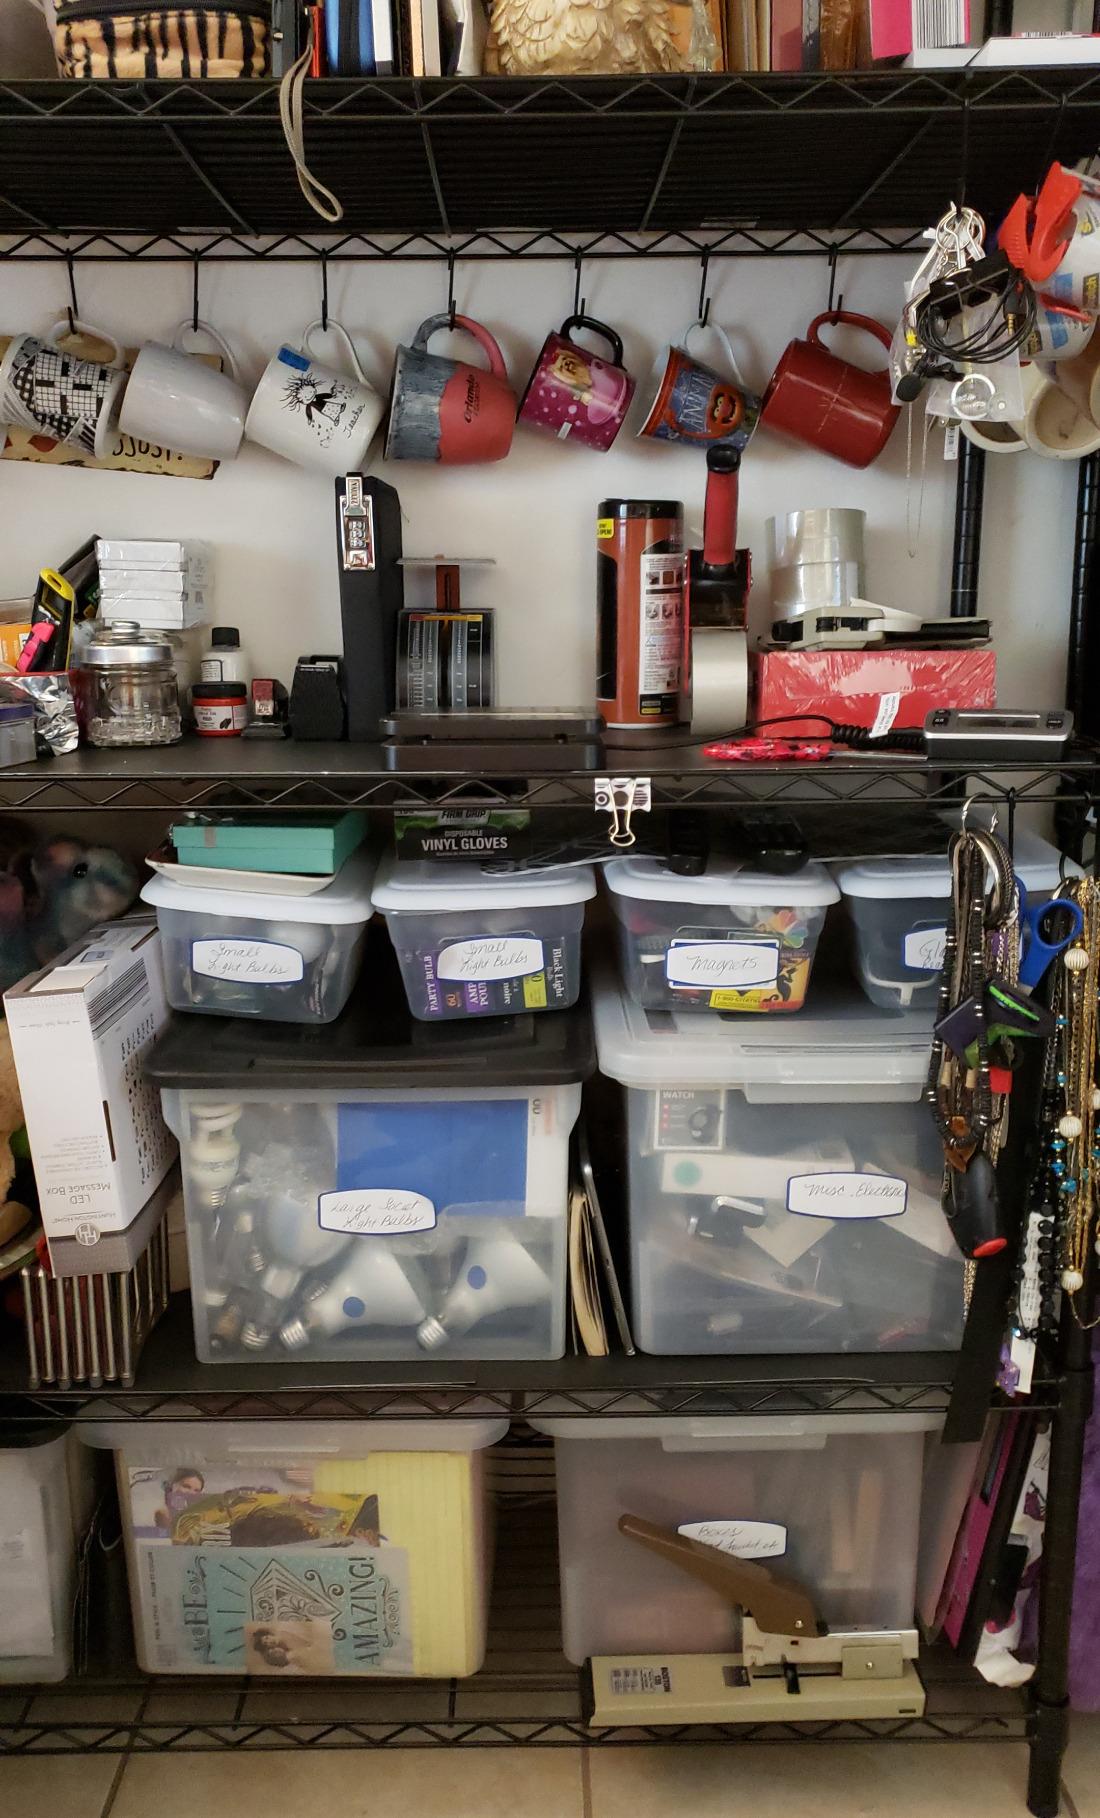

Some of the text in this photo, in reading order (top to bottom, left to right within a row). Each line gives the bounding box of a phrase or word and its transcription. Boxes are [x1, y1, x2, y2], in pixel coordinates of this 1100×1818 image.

[421, 837, 508, 851] VINYL GLOVES
[464, 940, 507, 956] Small
[552, 947, 565, 998] Black Light
[686, 953, 759, 976] Magnets
[424, 955, 439, 1012] PARTY BULB
[468, 981, 479, 1005] AMP
[503, 982, 513, 1005] noire
[46, 1182, 112, 1196] MESSAGE BOX
[69, 1194, 91, 1204] LED
[183, 1594, 209, 1625] BE
[347, 1556, 380, 1666] AMAZING!
